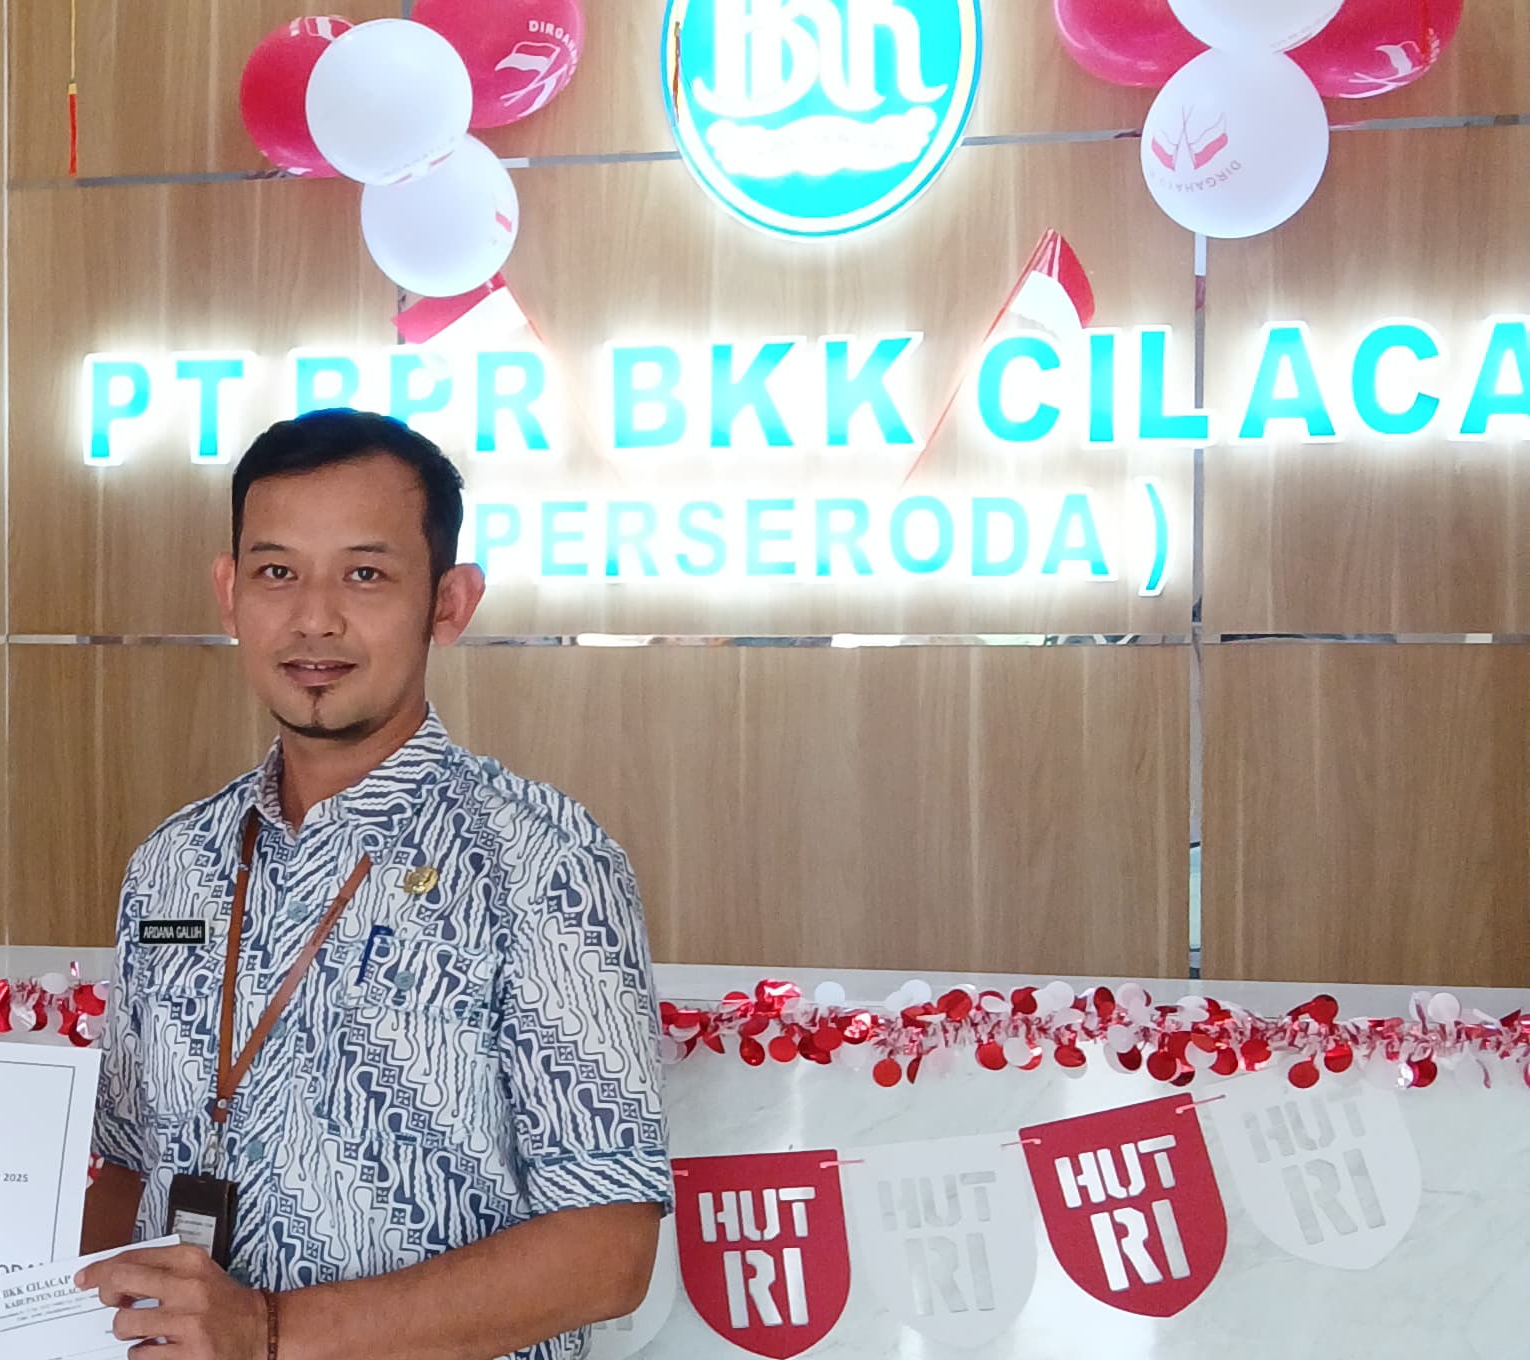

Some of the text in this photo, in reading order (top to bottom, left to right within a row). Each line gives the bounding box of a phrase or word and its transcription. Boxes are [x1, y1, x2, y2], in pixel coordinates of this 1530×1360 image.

[88, 359, 245, 459] PT
[611, 337, 916, 450] BKK
[1241, 1087, 1368, 1164] HUT
[3, 1173, 29, 1182] 2025
[877, 1171, 996, 1231] HUT
[1052, 1134, 1179, 1209] HUT
[1280, 1147, 1388, 1246] RI
[697, 1186, 817, 1243] HUT
[1088, 1198, 1192, 1293] RI
[722, 1247, 810, 1329] RI
[903, 1237, 996, 1317] RI
